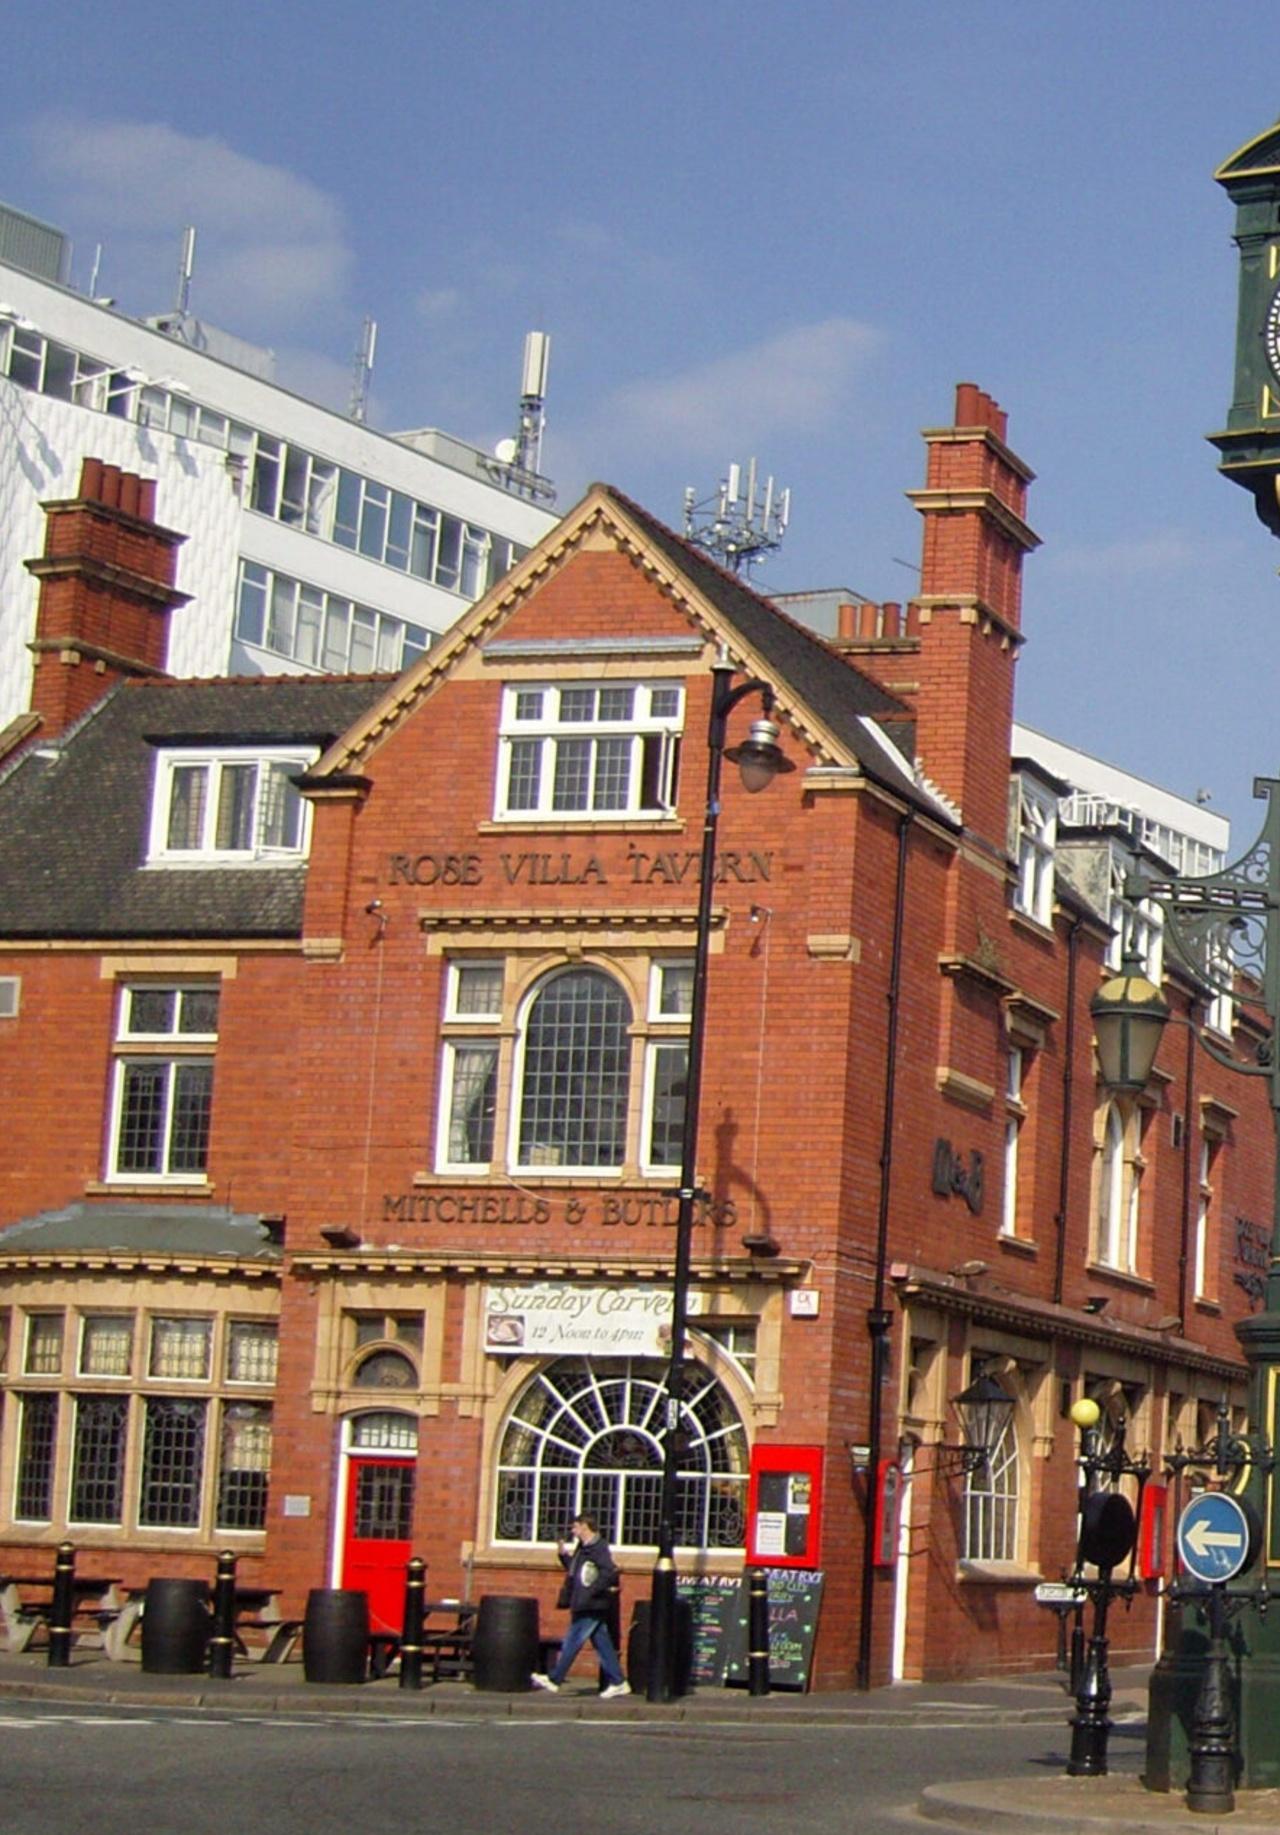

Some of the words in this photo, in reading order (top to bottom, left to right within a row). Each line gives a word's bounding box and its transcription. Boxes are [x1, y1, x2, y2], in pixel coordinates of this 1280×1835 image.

[388, 852, 483, 887] ROSE
[499, 852, 606, 887] VILLA
[382, 1194, 551, 1224] MITCHELLS
[565, 1197, 587, 1226] &
[489, 1287, 592, 1319] Sunday
[549, 1322, 592, 1344] Noon
[594, 1325, 609, 1340] to
[611, 1326, 645, 1343] 4pm
